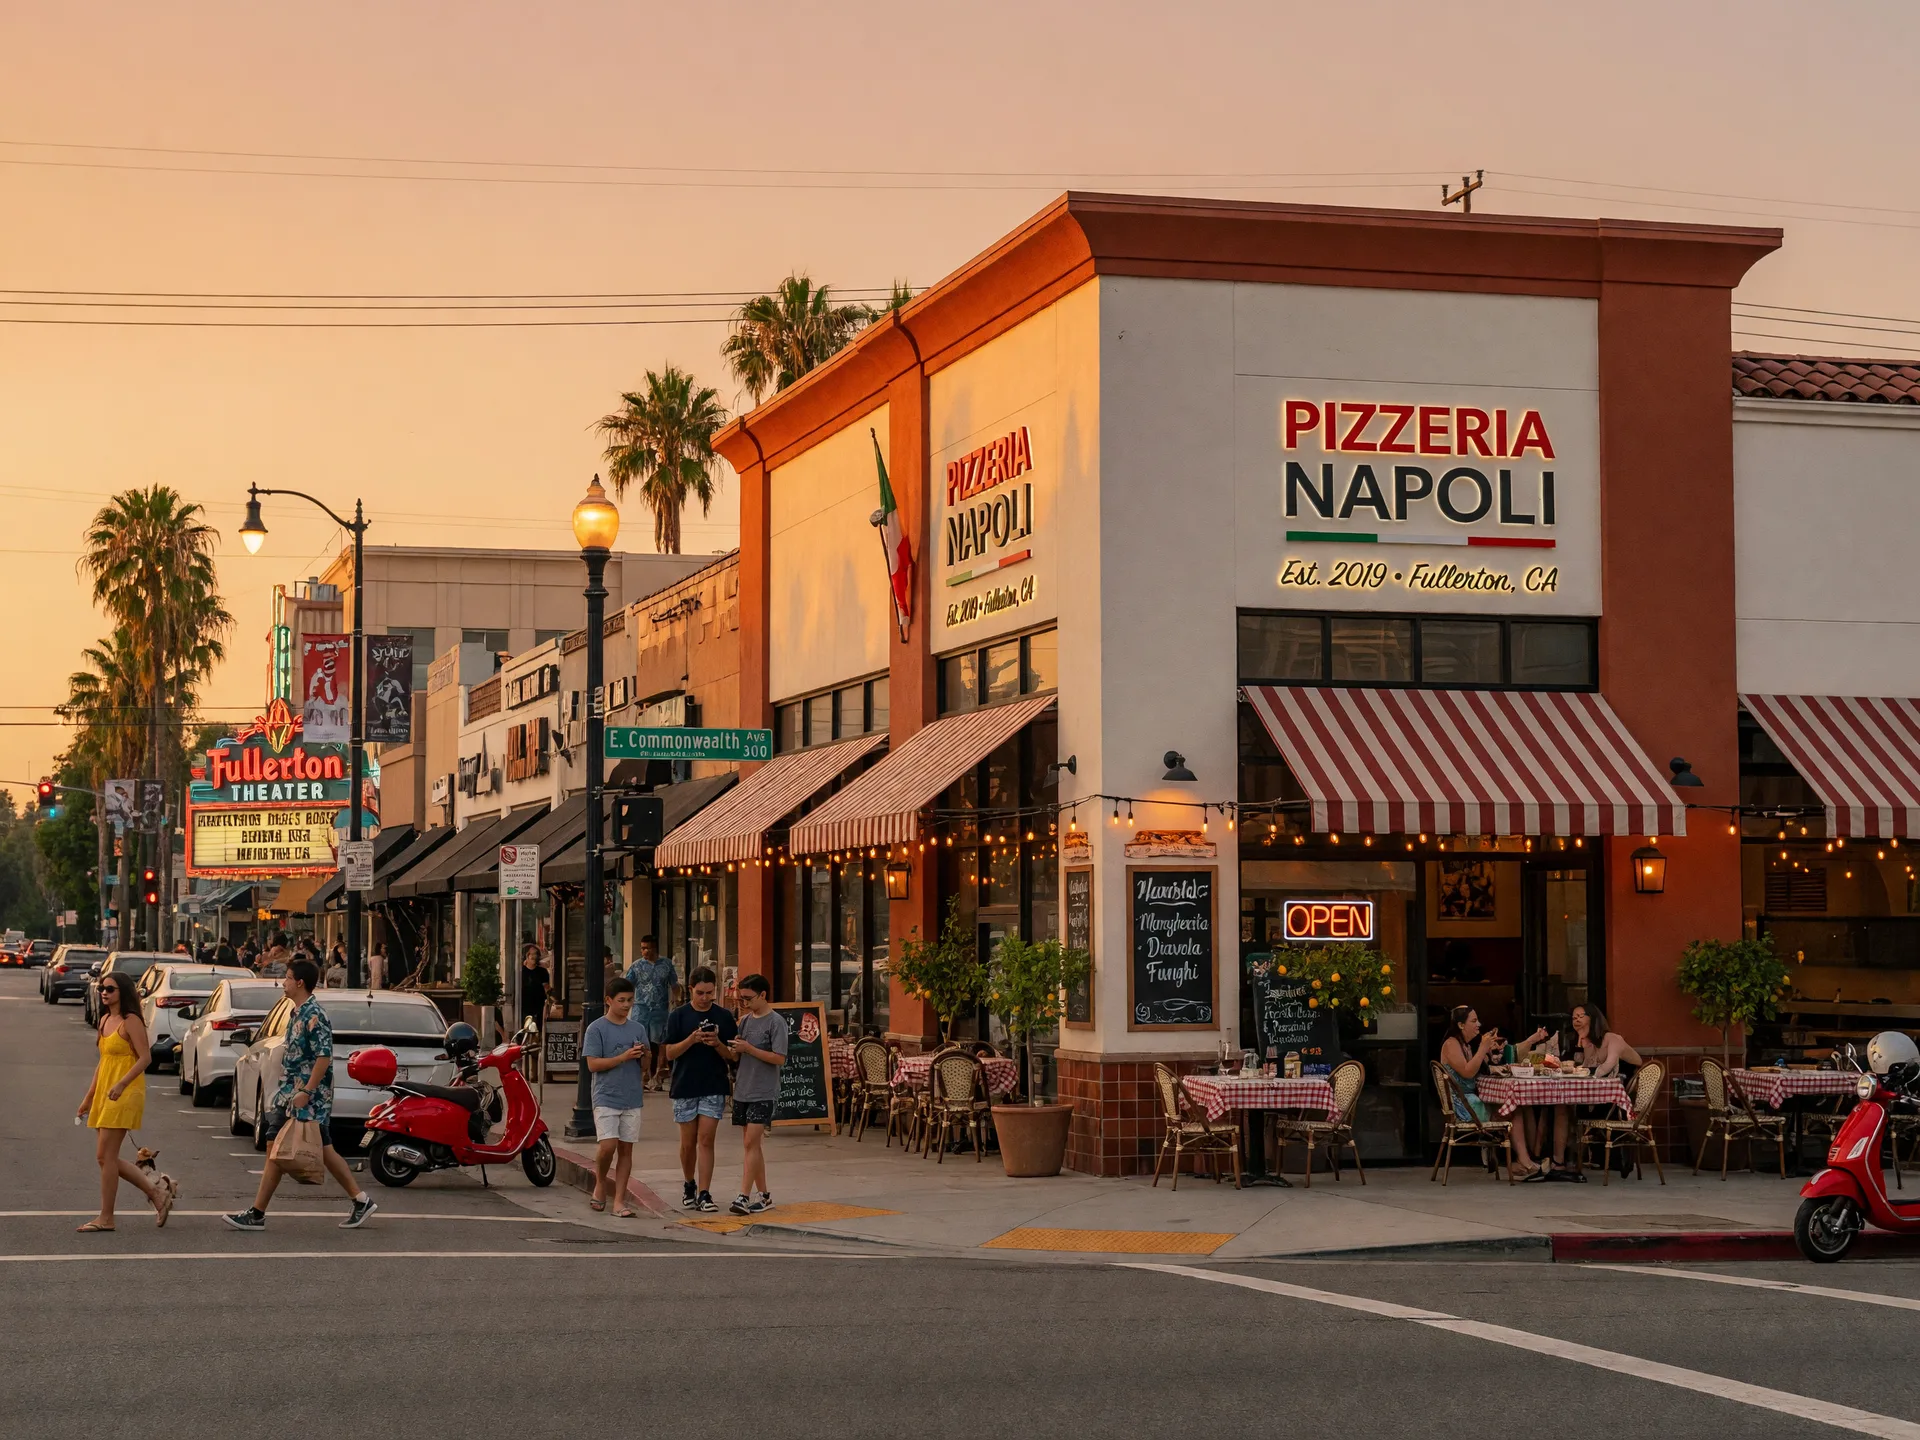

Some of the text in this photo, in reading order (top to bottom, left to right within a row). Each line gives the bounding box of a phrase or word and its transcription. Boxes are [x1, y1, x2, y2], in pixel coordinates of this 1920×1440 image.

[1285, 400, 1556, 459] PIZZERIA
[946, 426, 1033, 506] PIZZERIA
[1285, 461, 1556, 525] NAPOLI
[946, 483, 1033, 566] NAPOLI
[1280, 560, 1558, 593] Est. 2019 Fullerton, CA
[959, 595, 979, 623] 2019
[1020, 574, 1035, 602] CA
[609, 729, 623, 749] E.
[743, 744, 768, 758] 300
[206, 746, 344, 790] Fullerton
[231, 781, 324, 802] THEATER
[1287, 904, 1370, 937] OPEN
[1146, 936, 1203, 958] Diavola
